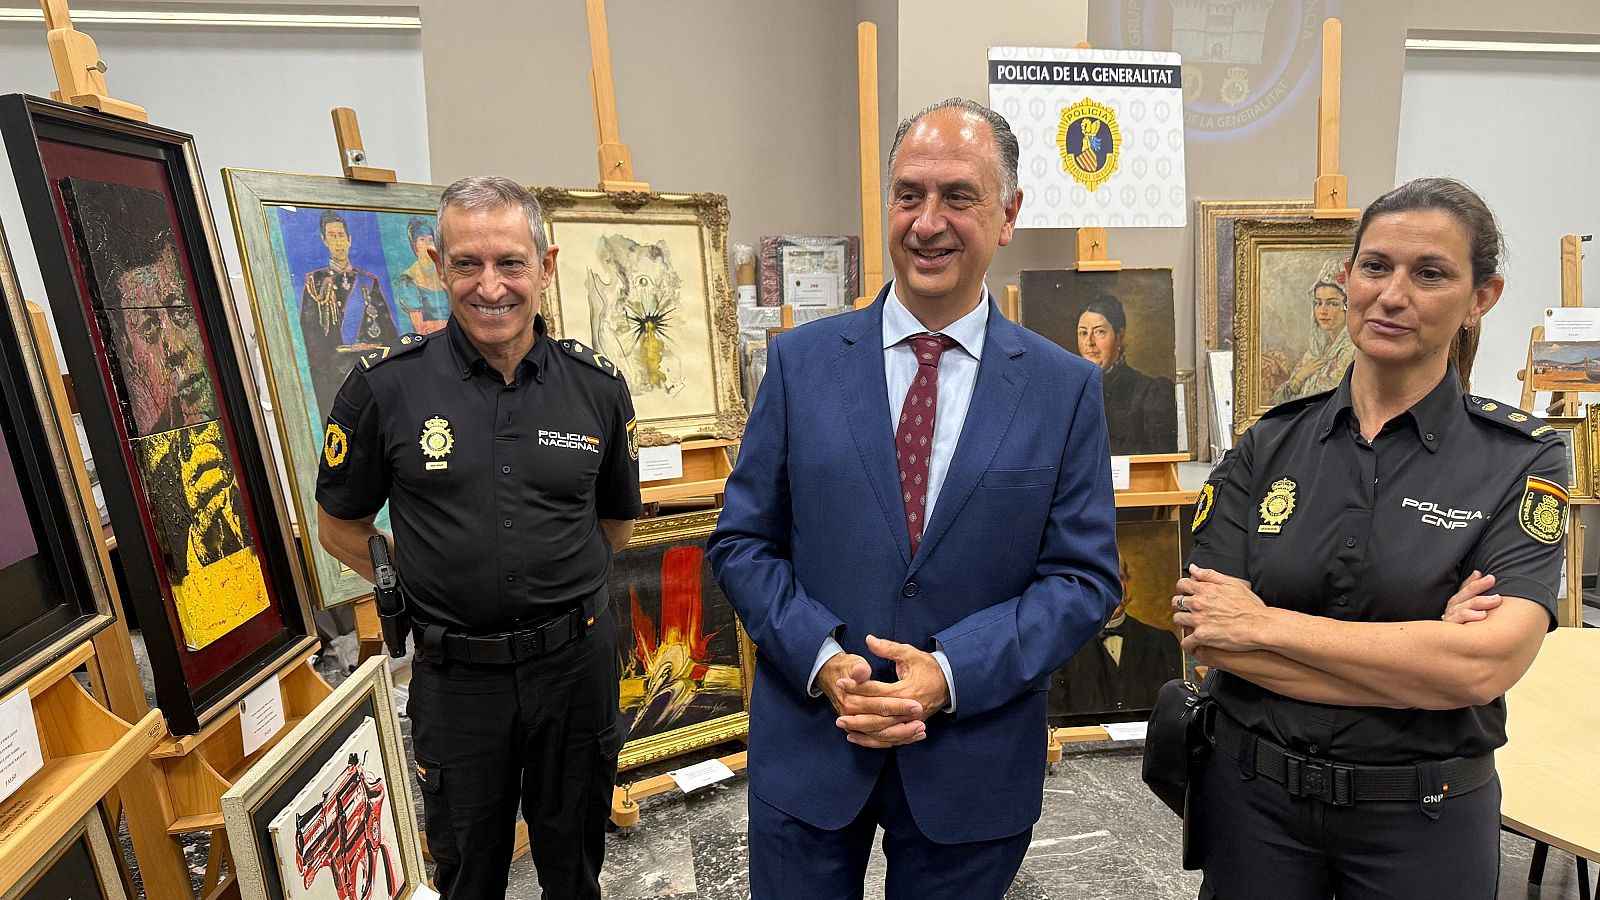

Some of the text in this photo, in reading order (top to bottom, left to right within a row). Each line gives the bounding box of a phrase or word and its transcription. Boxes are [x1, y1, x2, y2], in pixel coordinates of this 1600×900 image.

[997, 65, 1173, 84] POLICIA DE LA GENERALITAT
[1200, 117, 1214, 128] LA
[1216, 80, 1289, 128] GENERALITAT
[1066, 108, 1108, 121] POLICIA
[538, 430, 588, 443] POLICIA
[538, 438, 599, 453] NACIONAL
[1401, 497, 1483, 520] POLICIA
[1421, 514, 1468, 530] CNP
[1423, 793, 1444, 803] CNP
